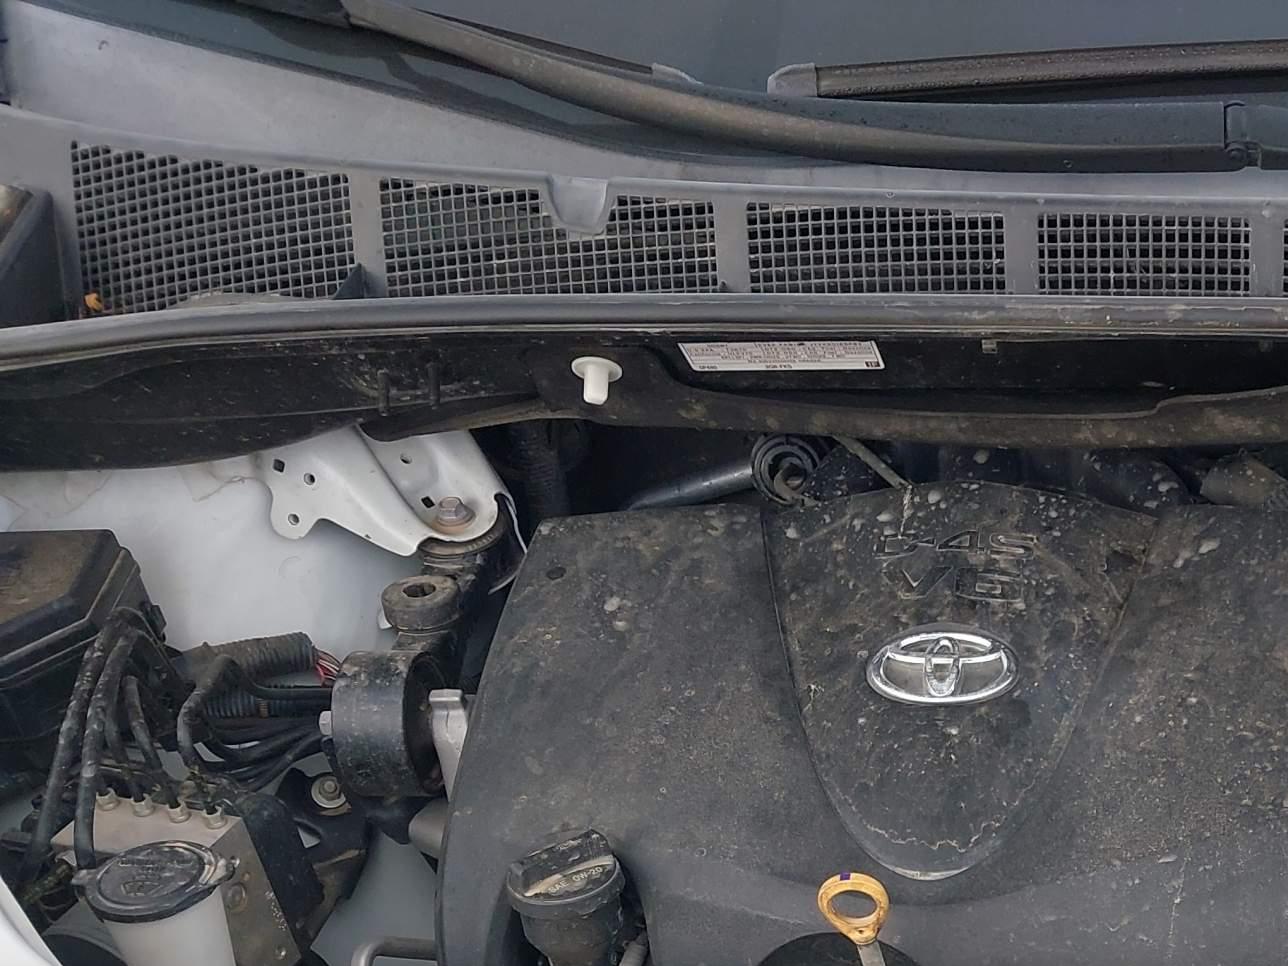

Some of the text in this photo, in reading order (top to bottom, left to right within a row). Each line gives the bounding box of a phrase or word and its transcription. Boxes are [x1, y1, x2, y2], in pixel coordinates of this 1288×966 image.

[882, 565, 1024, 602] V6
[547, 866, 603, 894] SAE 0W-20
